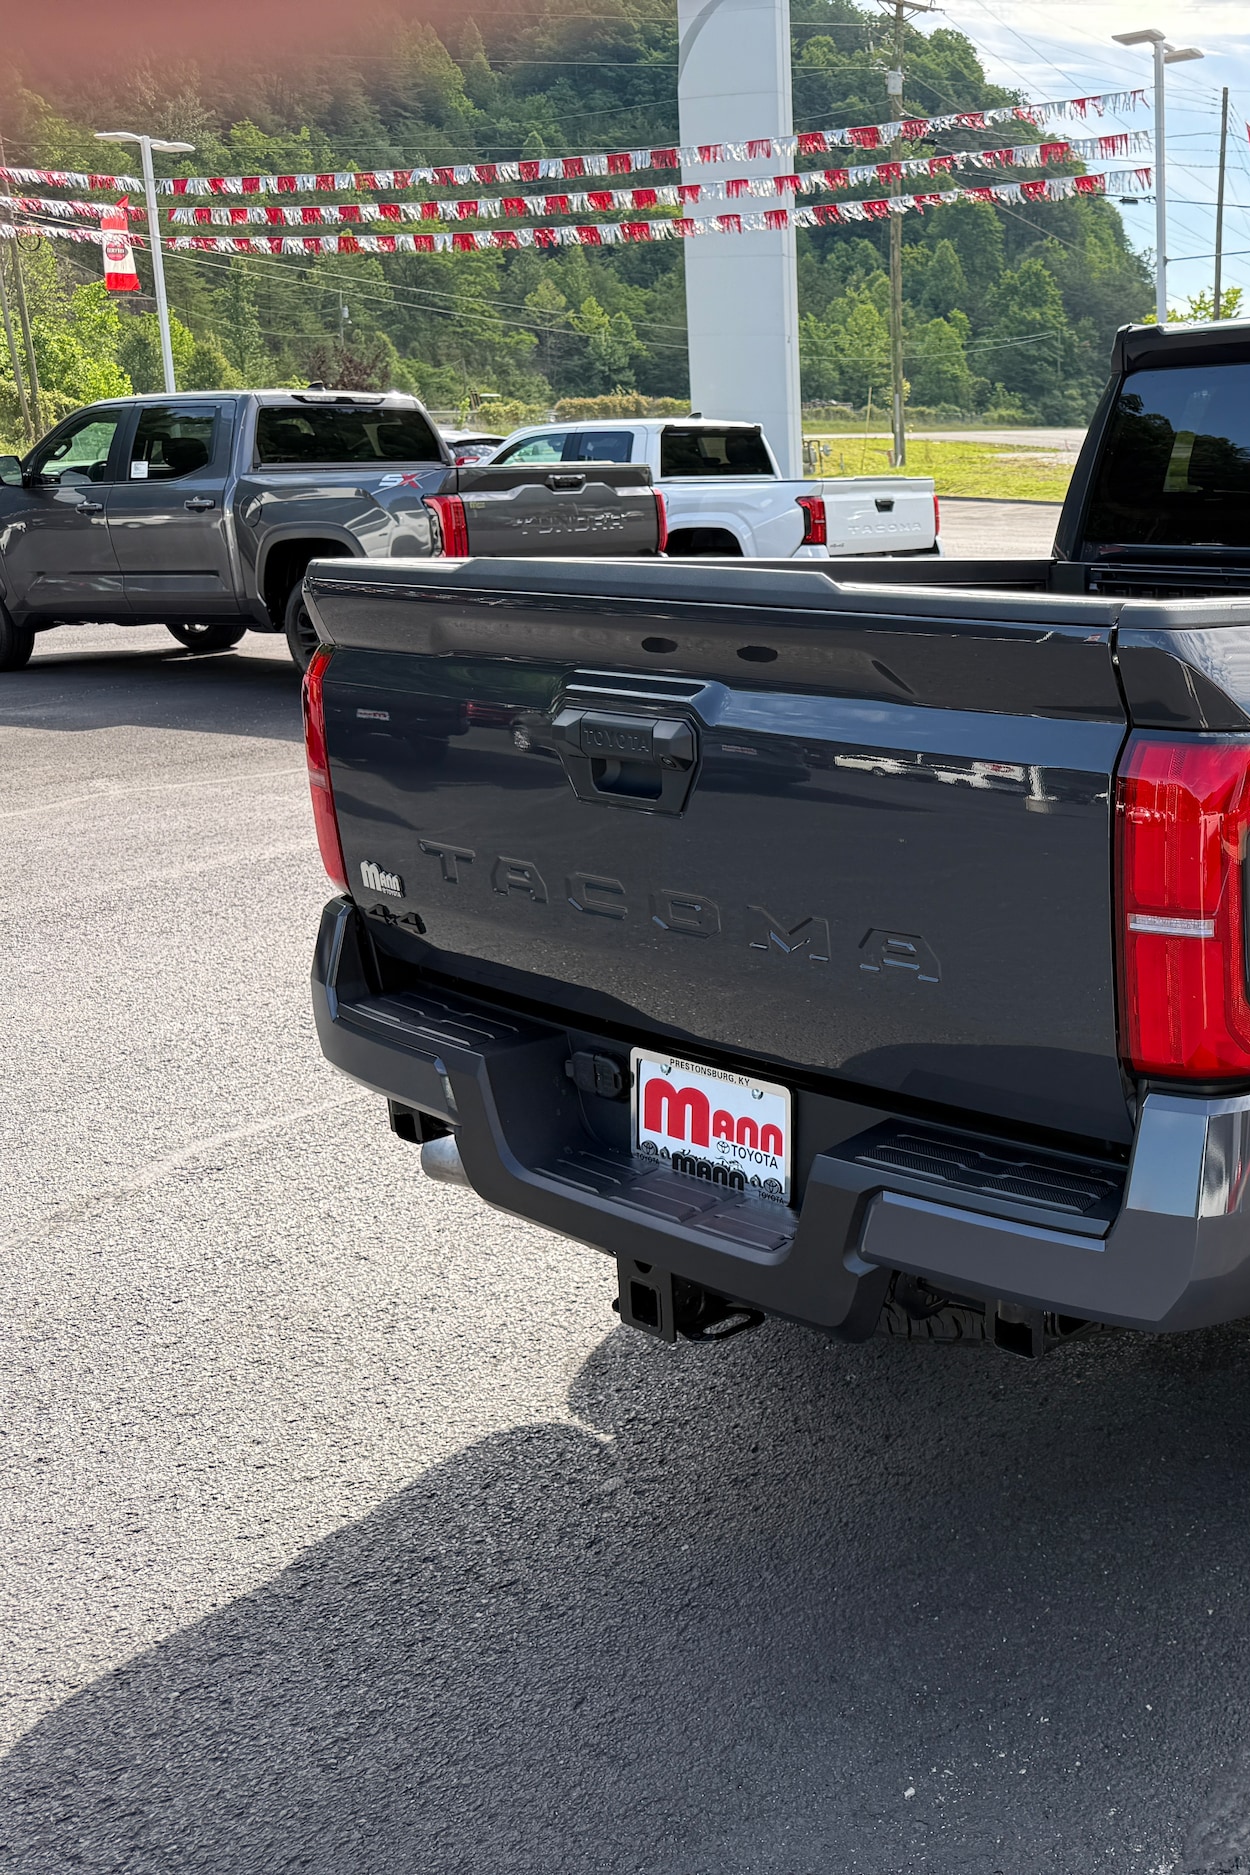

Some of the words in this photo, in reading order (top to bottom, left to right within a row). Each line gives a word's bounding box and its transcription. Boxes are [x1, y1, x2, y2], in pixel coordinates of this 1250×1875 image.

[847, 522, 922, 535] TACOMA
[583, 729, 650, 753] TOYOTA
[417, 838, 942, 984] TACOMA
[669, 1058, 737, 1084] PRESTONSBURG,
[738, 1076, 751, 1087] KY
[635, 1152, 660, 1165] TOYOTA
[731, 1144, 779, 1169] TOYOTA
